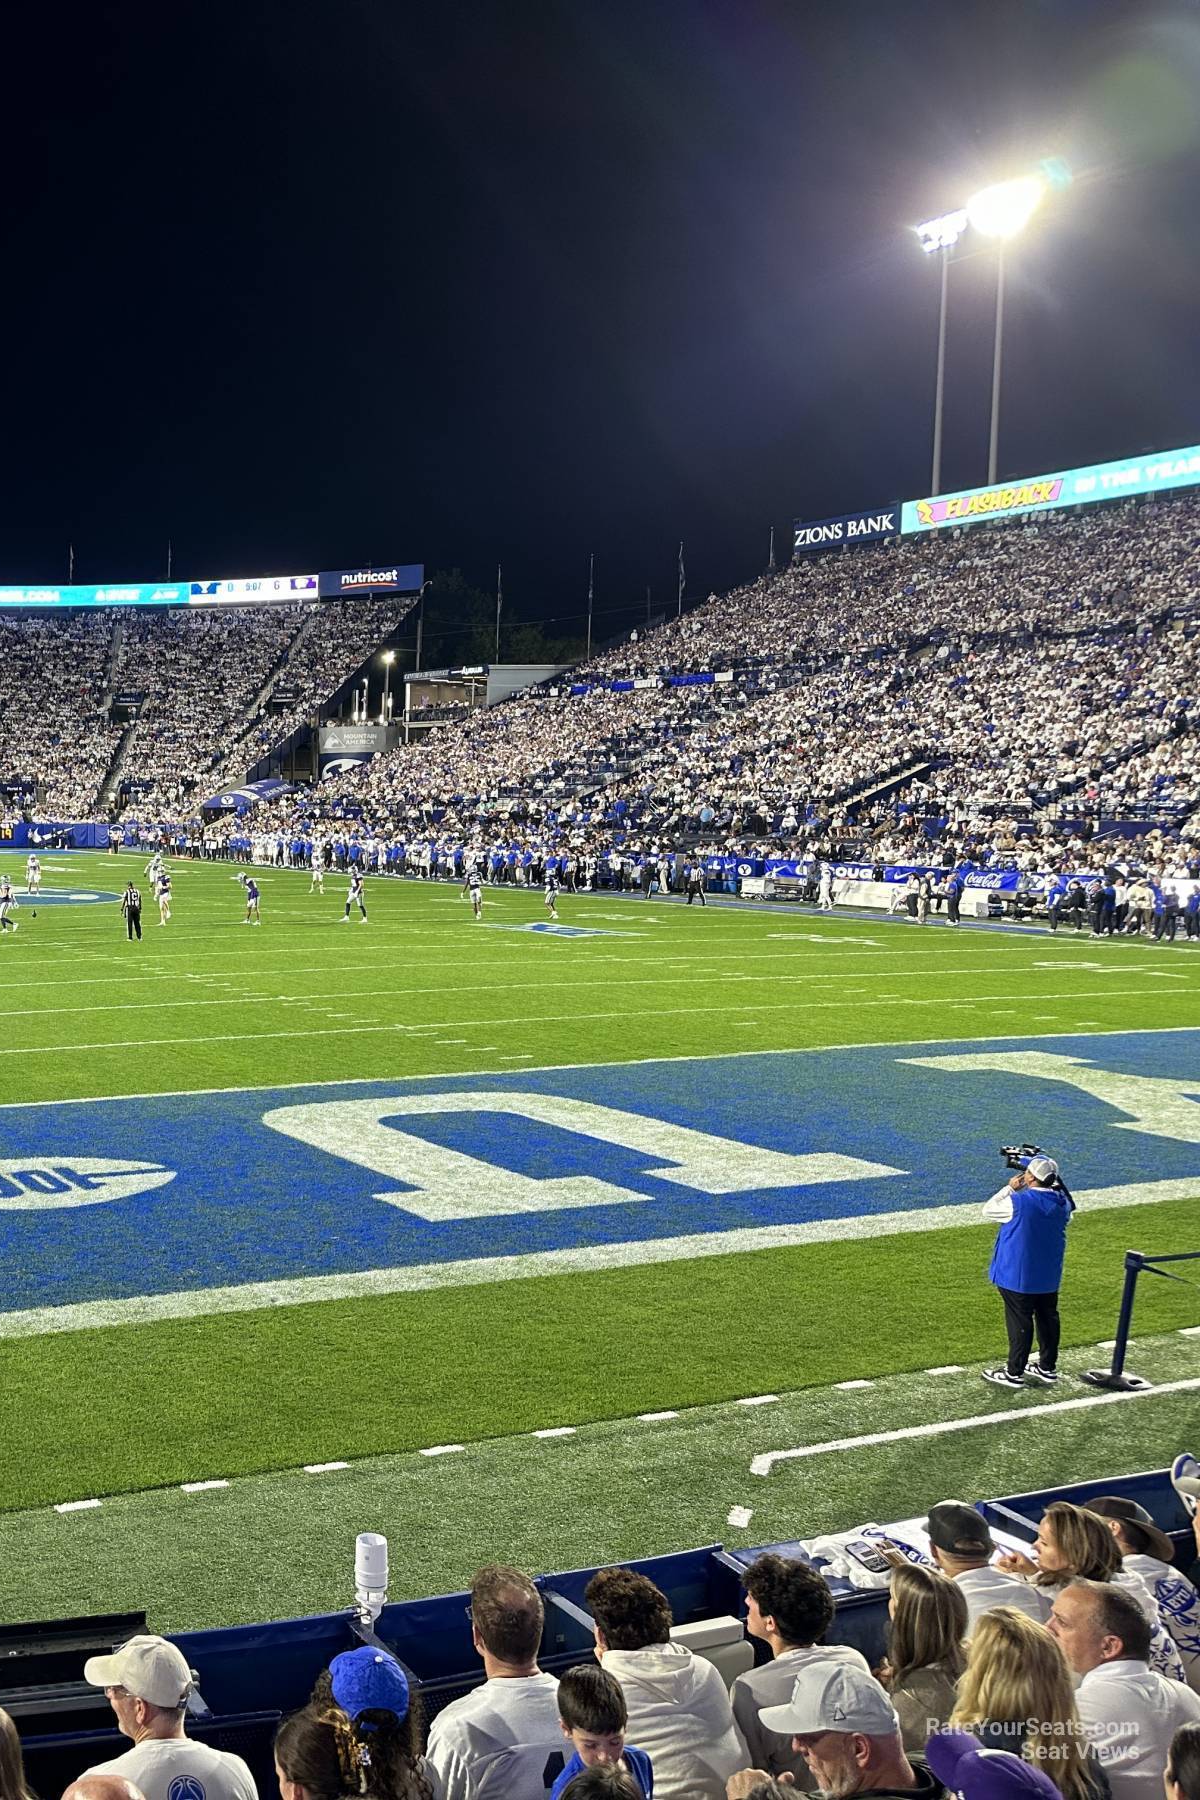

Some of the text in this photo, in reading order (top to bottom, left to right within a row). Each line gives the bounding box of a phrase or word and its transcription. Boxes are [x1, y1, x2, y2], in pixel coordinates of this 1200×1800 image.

[946, 482, 1056, 518] FLASHBACK
[794, 513, 895, 547] ZIONS BANK
[341, 569, 398, 585] nutricost
[1, 829, 11, 839] 19
[964, 872, 1001, 889] Coca-Cola
[131, 892, 139, 901] C
[1167, 1587, 1191, 1610] BYU
